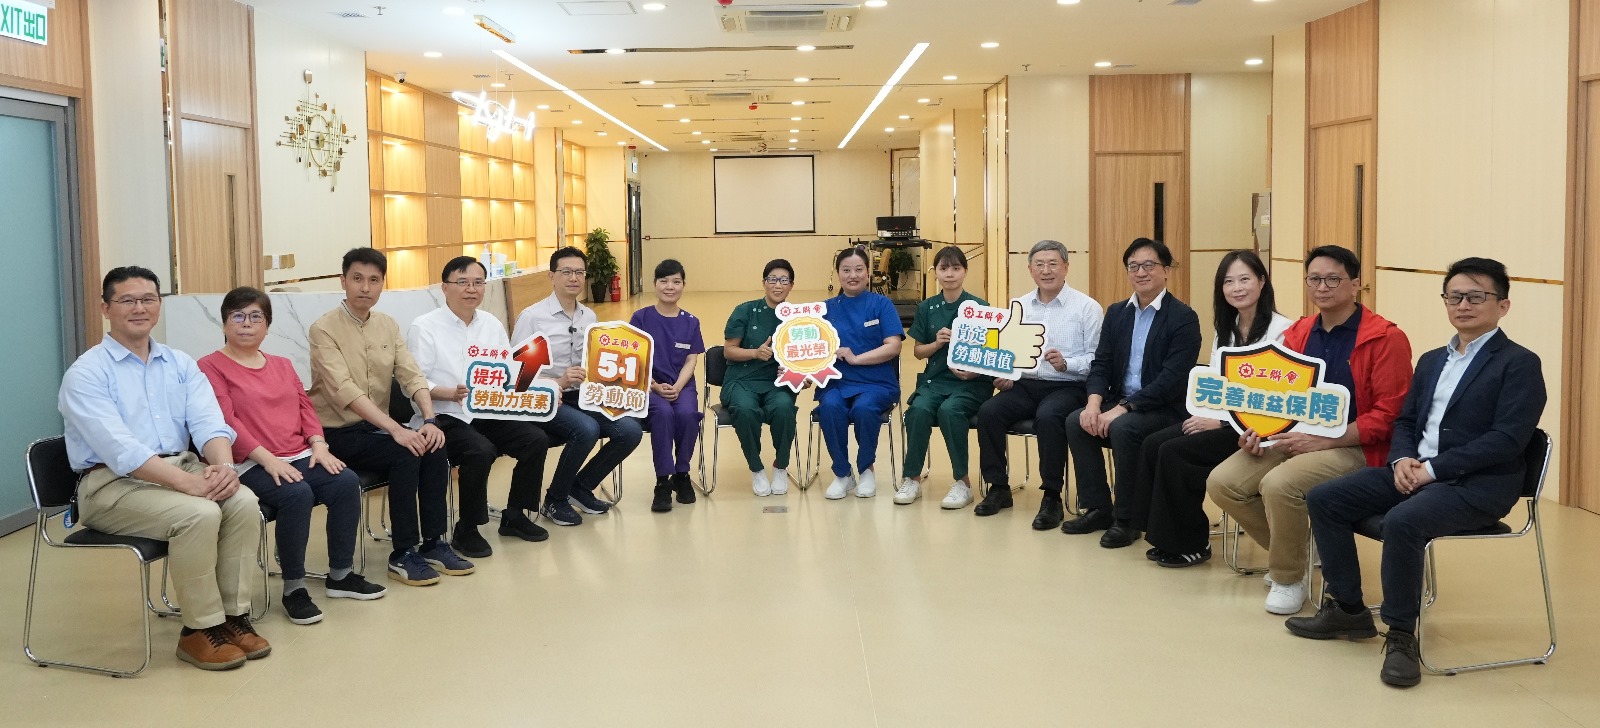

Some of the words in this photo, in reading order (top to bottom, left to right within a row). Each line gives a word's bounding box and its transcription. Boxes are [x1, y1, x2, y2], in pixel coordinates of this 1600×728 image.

[792, 304, 822, 314] 工聯會
[975, 310, 1005, 324] 工聯會
[791, 326, 818, 341] 勞動
[957, 323, 987, 343] 肯定
[611, 338, 640, 351] 工聯會
[786, 342, 827, 358] 最光榮
[480, 348, 509, 360] 工聯會
[953, 344, 1013, 371] 勞動價值
[473, 367, 505, 386] 提升
[1256, 368, 1299, 384] 工聯會
[473, 389, 549, 410] 勞動力質素
[584, 384, 644, 409] 勞動節
[1195, 376, 1340, 422] 完善權益保障
